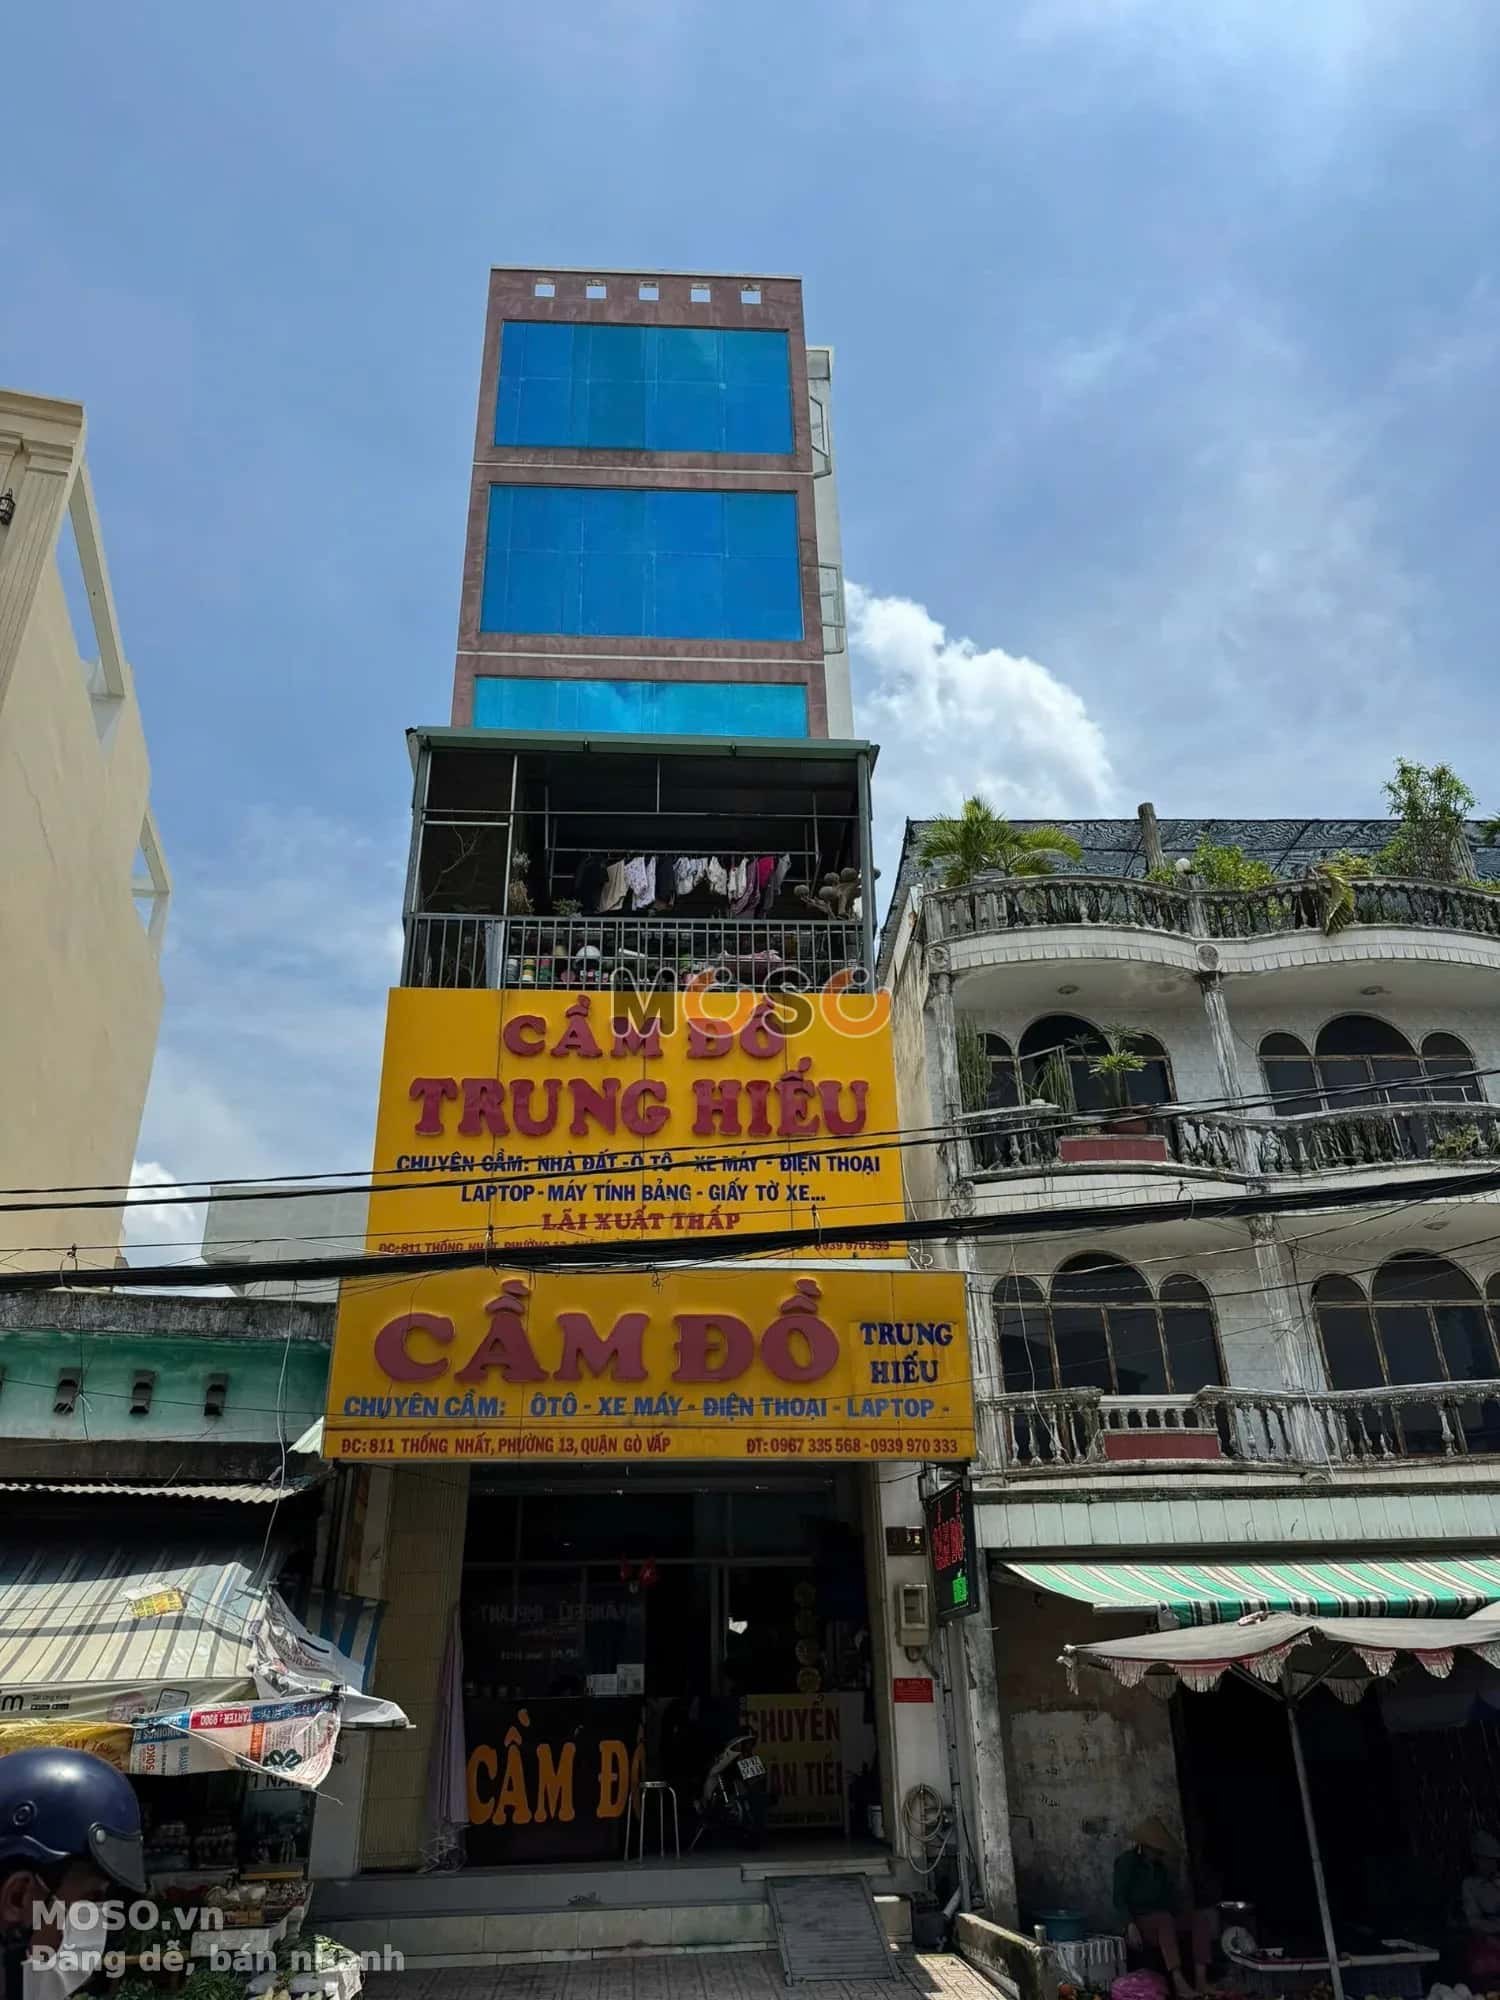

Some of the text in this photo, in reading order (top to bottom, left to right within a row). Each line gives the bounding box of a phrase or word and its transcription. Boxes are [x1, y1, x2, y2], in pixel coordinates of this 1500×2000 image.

[409, 1056, 869, 1137] TRUNG HIẾU
[397, 1151, 474, 1172] CHUYÊN
[537, 1151, 575, 1172] NHÀ
[582, 1148, 617, 1171] ĐẤT
[650, 1152, 672, 1172] TÔ
[694, 1155, 716, 1172] XE
[722, 1150, 759, 1172] MÁY
[780, 1153, 821, 1176] ĐIỆN
[826, 1155, 880, 1176] THOẠI
[461, 1184, 534, 1202] LAPTOP
[548, 1179, 587, 1201] MÁY
[593, 1179, 635, 1201] TÍNH
[641, 1177, 691, 1201] BẢNG
[708, 1177, 748, 1201] GIẤY
[755, 1180, 779, 1201] TỜ
[542, 1204, 741, 1230] LÃI XUẤT THẤP
[374, 1278, 840, 1384] CẦM ĐỒ
[859, 1322, 953, 1346] TRUNG
[870, 1350, 938, 1384] HIẾU
[344, 1392, 439, 1417] CHUYÊN
[444, 1388, 505, 1416] CẦM:
[530, 1391, 578, 1416] ÔTÔ
[599, 1397, 627, 1416] XE
[633, 1392, 684, 1417] MÁY
[703, 1392, 754, 1421] ĐIỆN
[763, 1397, 827, 1420] THOẠI
[848, 1398, 934, 1418] LAPTOP
[402, 1432, 448, 1453] THỐNG
[455, 1432, 495, 1454] NHẤT,
[499, 1433, 553, 1453] PHƯỜNG
[581, 1434, 617, 1456] QUẬN
[623, 1433, 642, 1453] GÒ
[647, 1431, 670, 1453] VẤP
[808, 1438, 832, 1452] 335
[835, 1438, 861, 1452] 568
[907, 1438, 930, 1453] 970
[933, 1438, 958, 1453] 333
[467, 1708, 576, 1825] CẦM
